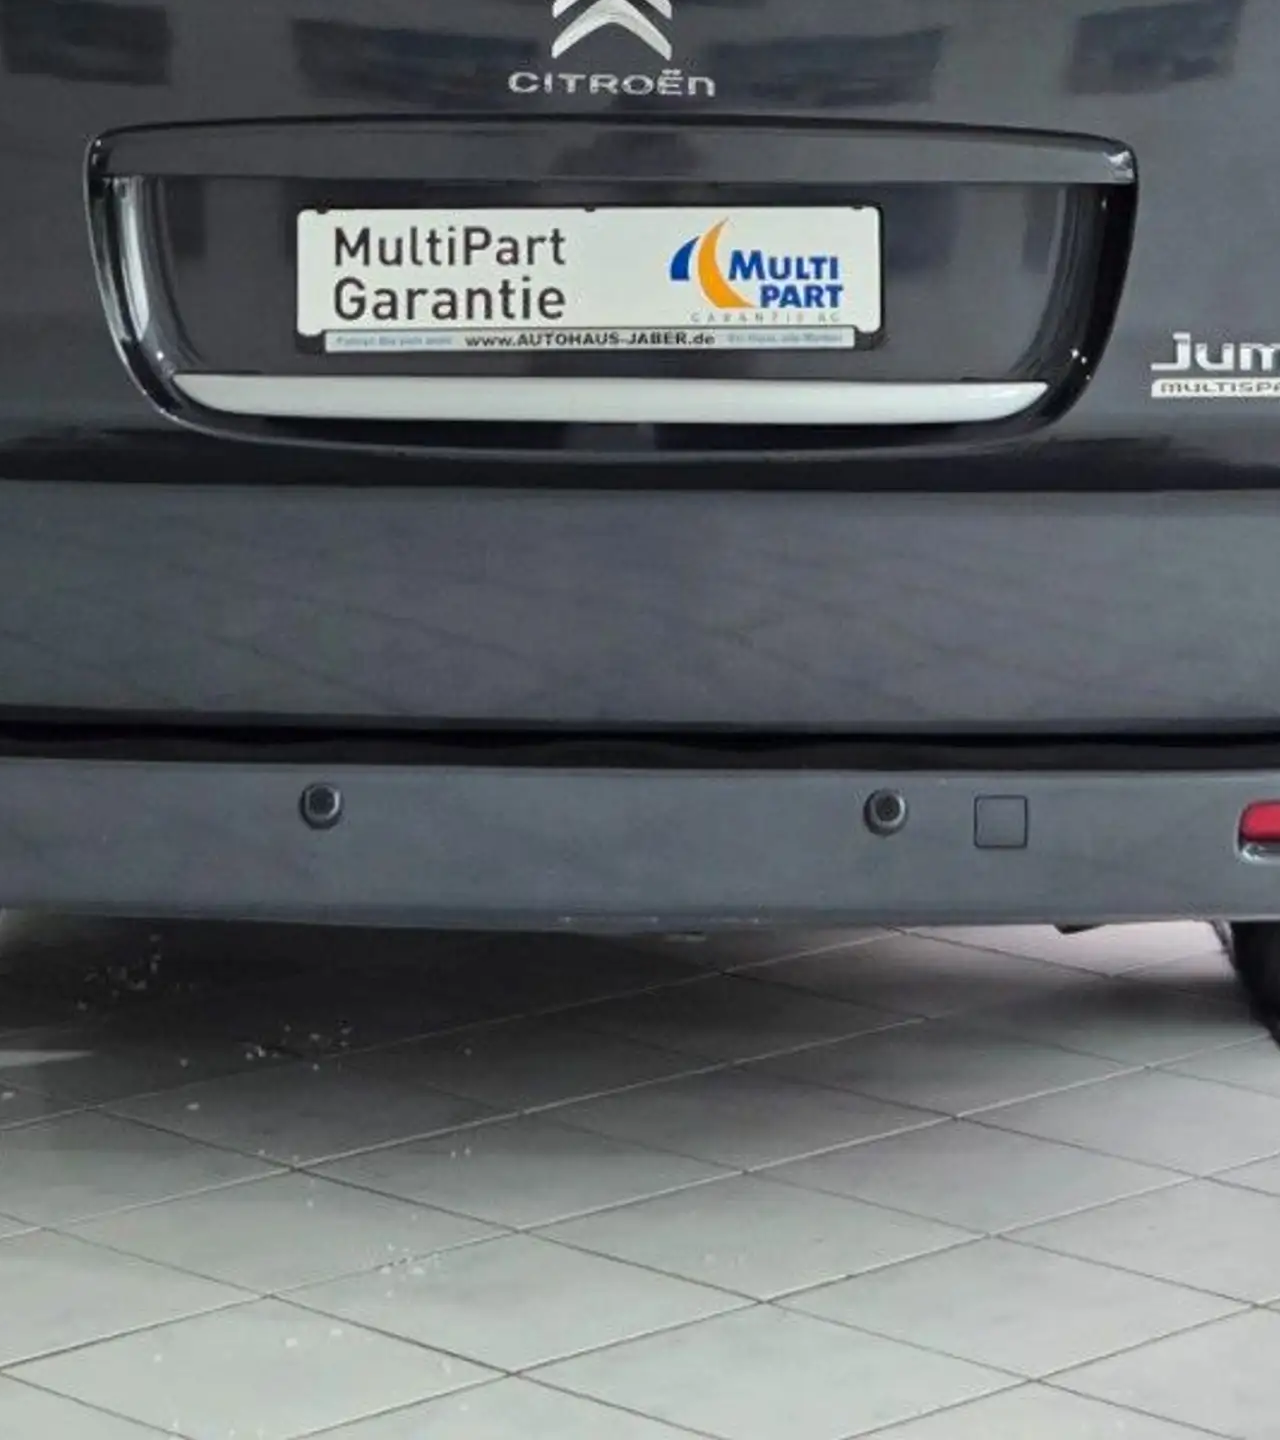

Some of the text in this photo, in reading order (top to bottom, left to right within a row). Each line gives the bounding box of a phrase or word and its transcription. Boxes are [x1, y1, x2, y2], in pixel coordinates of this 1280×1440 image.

[333, 224, 566, 268] MultiPart
[727, 249, 839, 281] MULTI
[333, 275, 567, 322] Garantie
[760, 284, 844, 309] PART
[464, 332, 716, 347] www.AUTOHAUS-JABER.de
